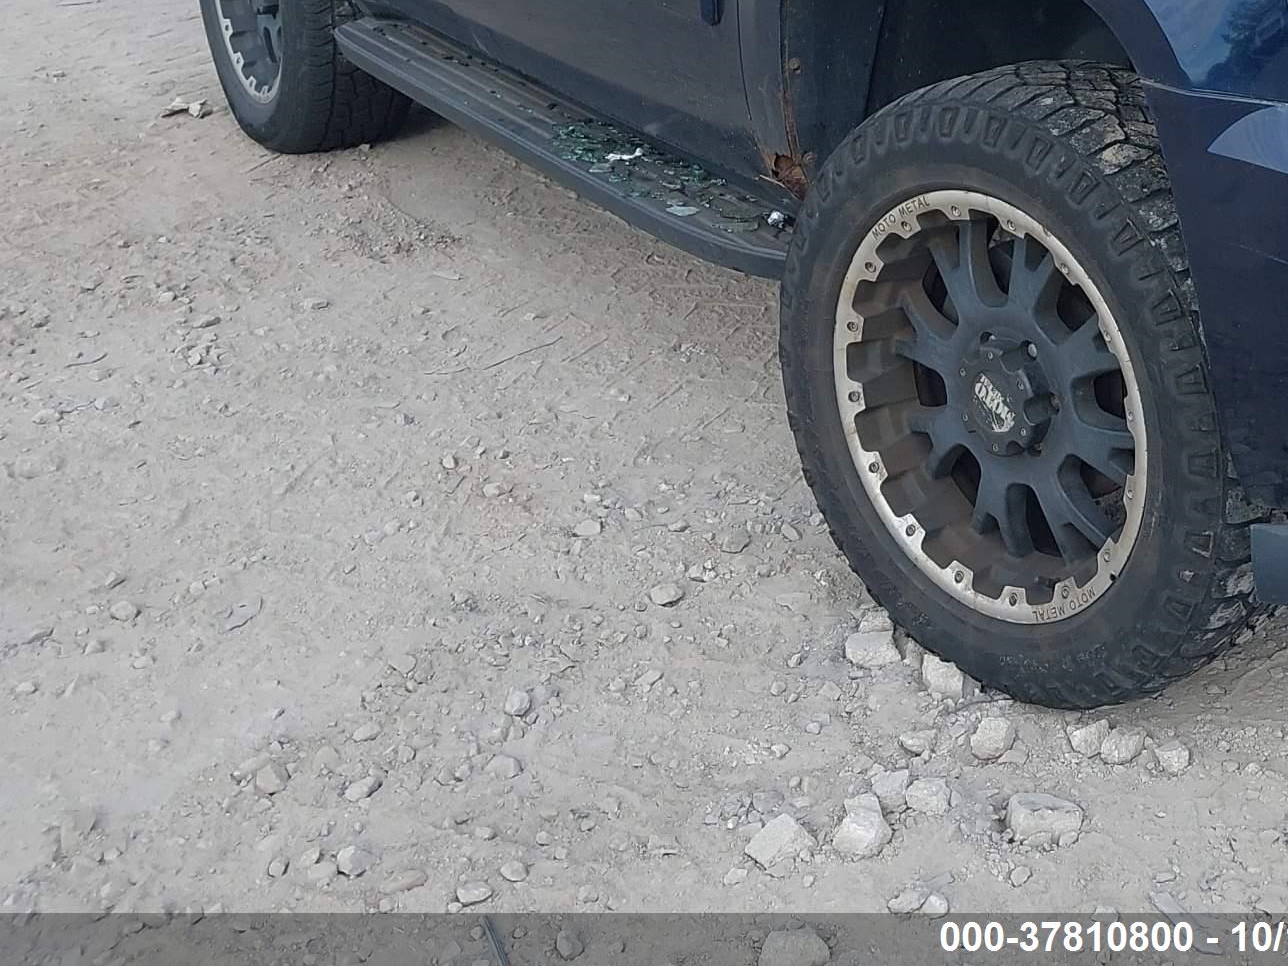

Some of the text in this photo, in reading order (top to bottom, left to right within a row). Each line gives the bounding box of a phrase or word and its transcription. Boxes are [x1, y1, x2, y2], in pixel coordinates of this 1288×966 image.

[871, 195, 931, 240] MOTO METAL
[1031, 585, 1097, 622] MOTO METAL
